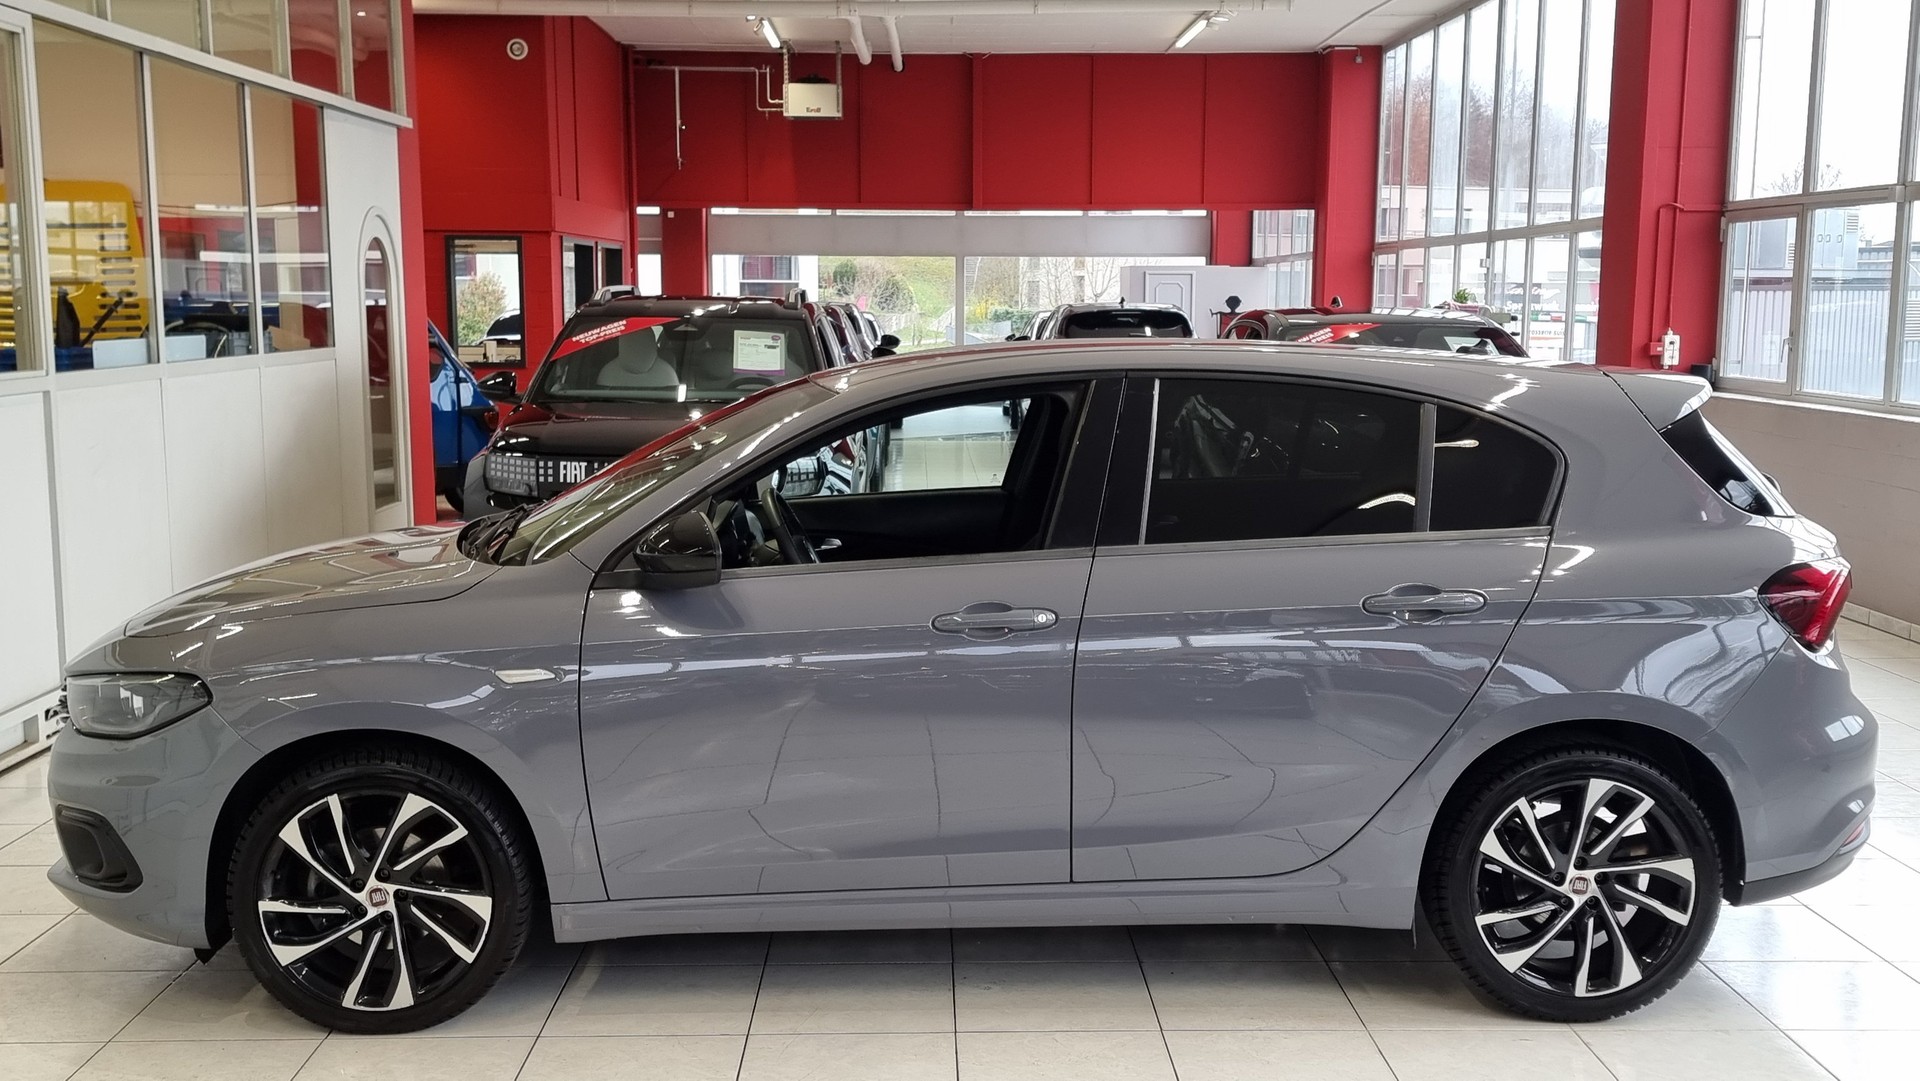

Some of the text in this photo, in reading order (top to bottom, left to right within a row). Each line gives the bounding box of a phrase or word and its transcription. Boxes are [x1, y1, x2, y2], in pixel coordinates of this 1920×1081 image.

[572, 320, 627, 342] NEUWAGEN
[579, 325, 626, 344] TOP-PREIS
[560, 461, 587, 483] FIAT
